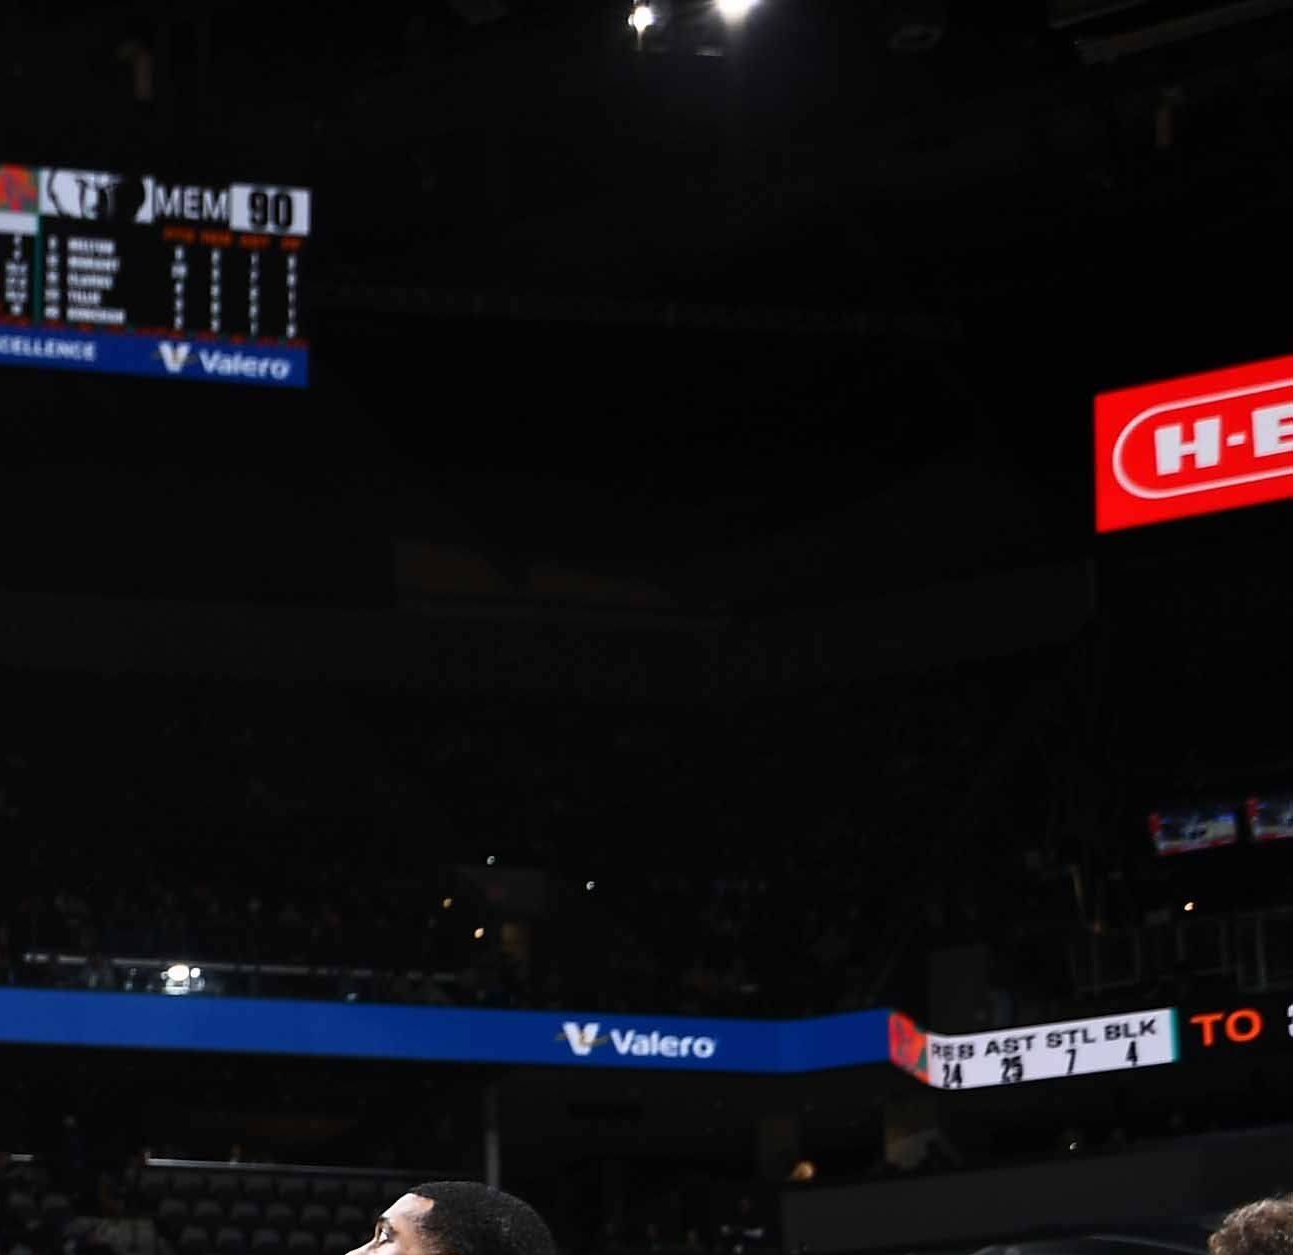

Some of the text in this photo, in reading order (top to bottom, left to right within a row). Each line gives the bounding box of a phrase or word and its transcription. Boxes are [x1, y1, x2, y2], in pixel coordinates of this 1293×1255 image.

[154, 184, 229, 222] MEM
[248, 190, 294, 231] 90
[199, 349, 292, 380] Valero
[609, 1028, 717, 1059] Valero
[984, 1034, 1037, 1058] AST
[1045, 1026, 1097, 1050] STL
[1103, 1018, 1158, 1043] BLK
[1189, 1008, 1264, 1047] TO
[1065, 1047, 1077, 1076] 7
[1124, 1040, 1139, 1068] 4
